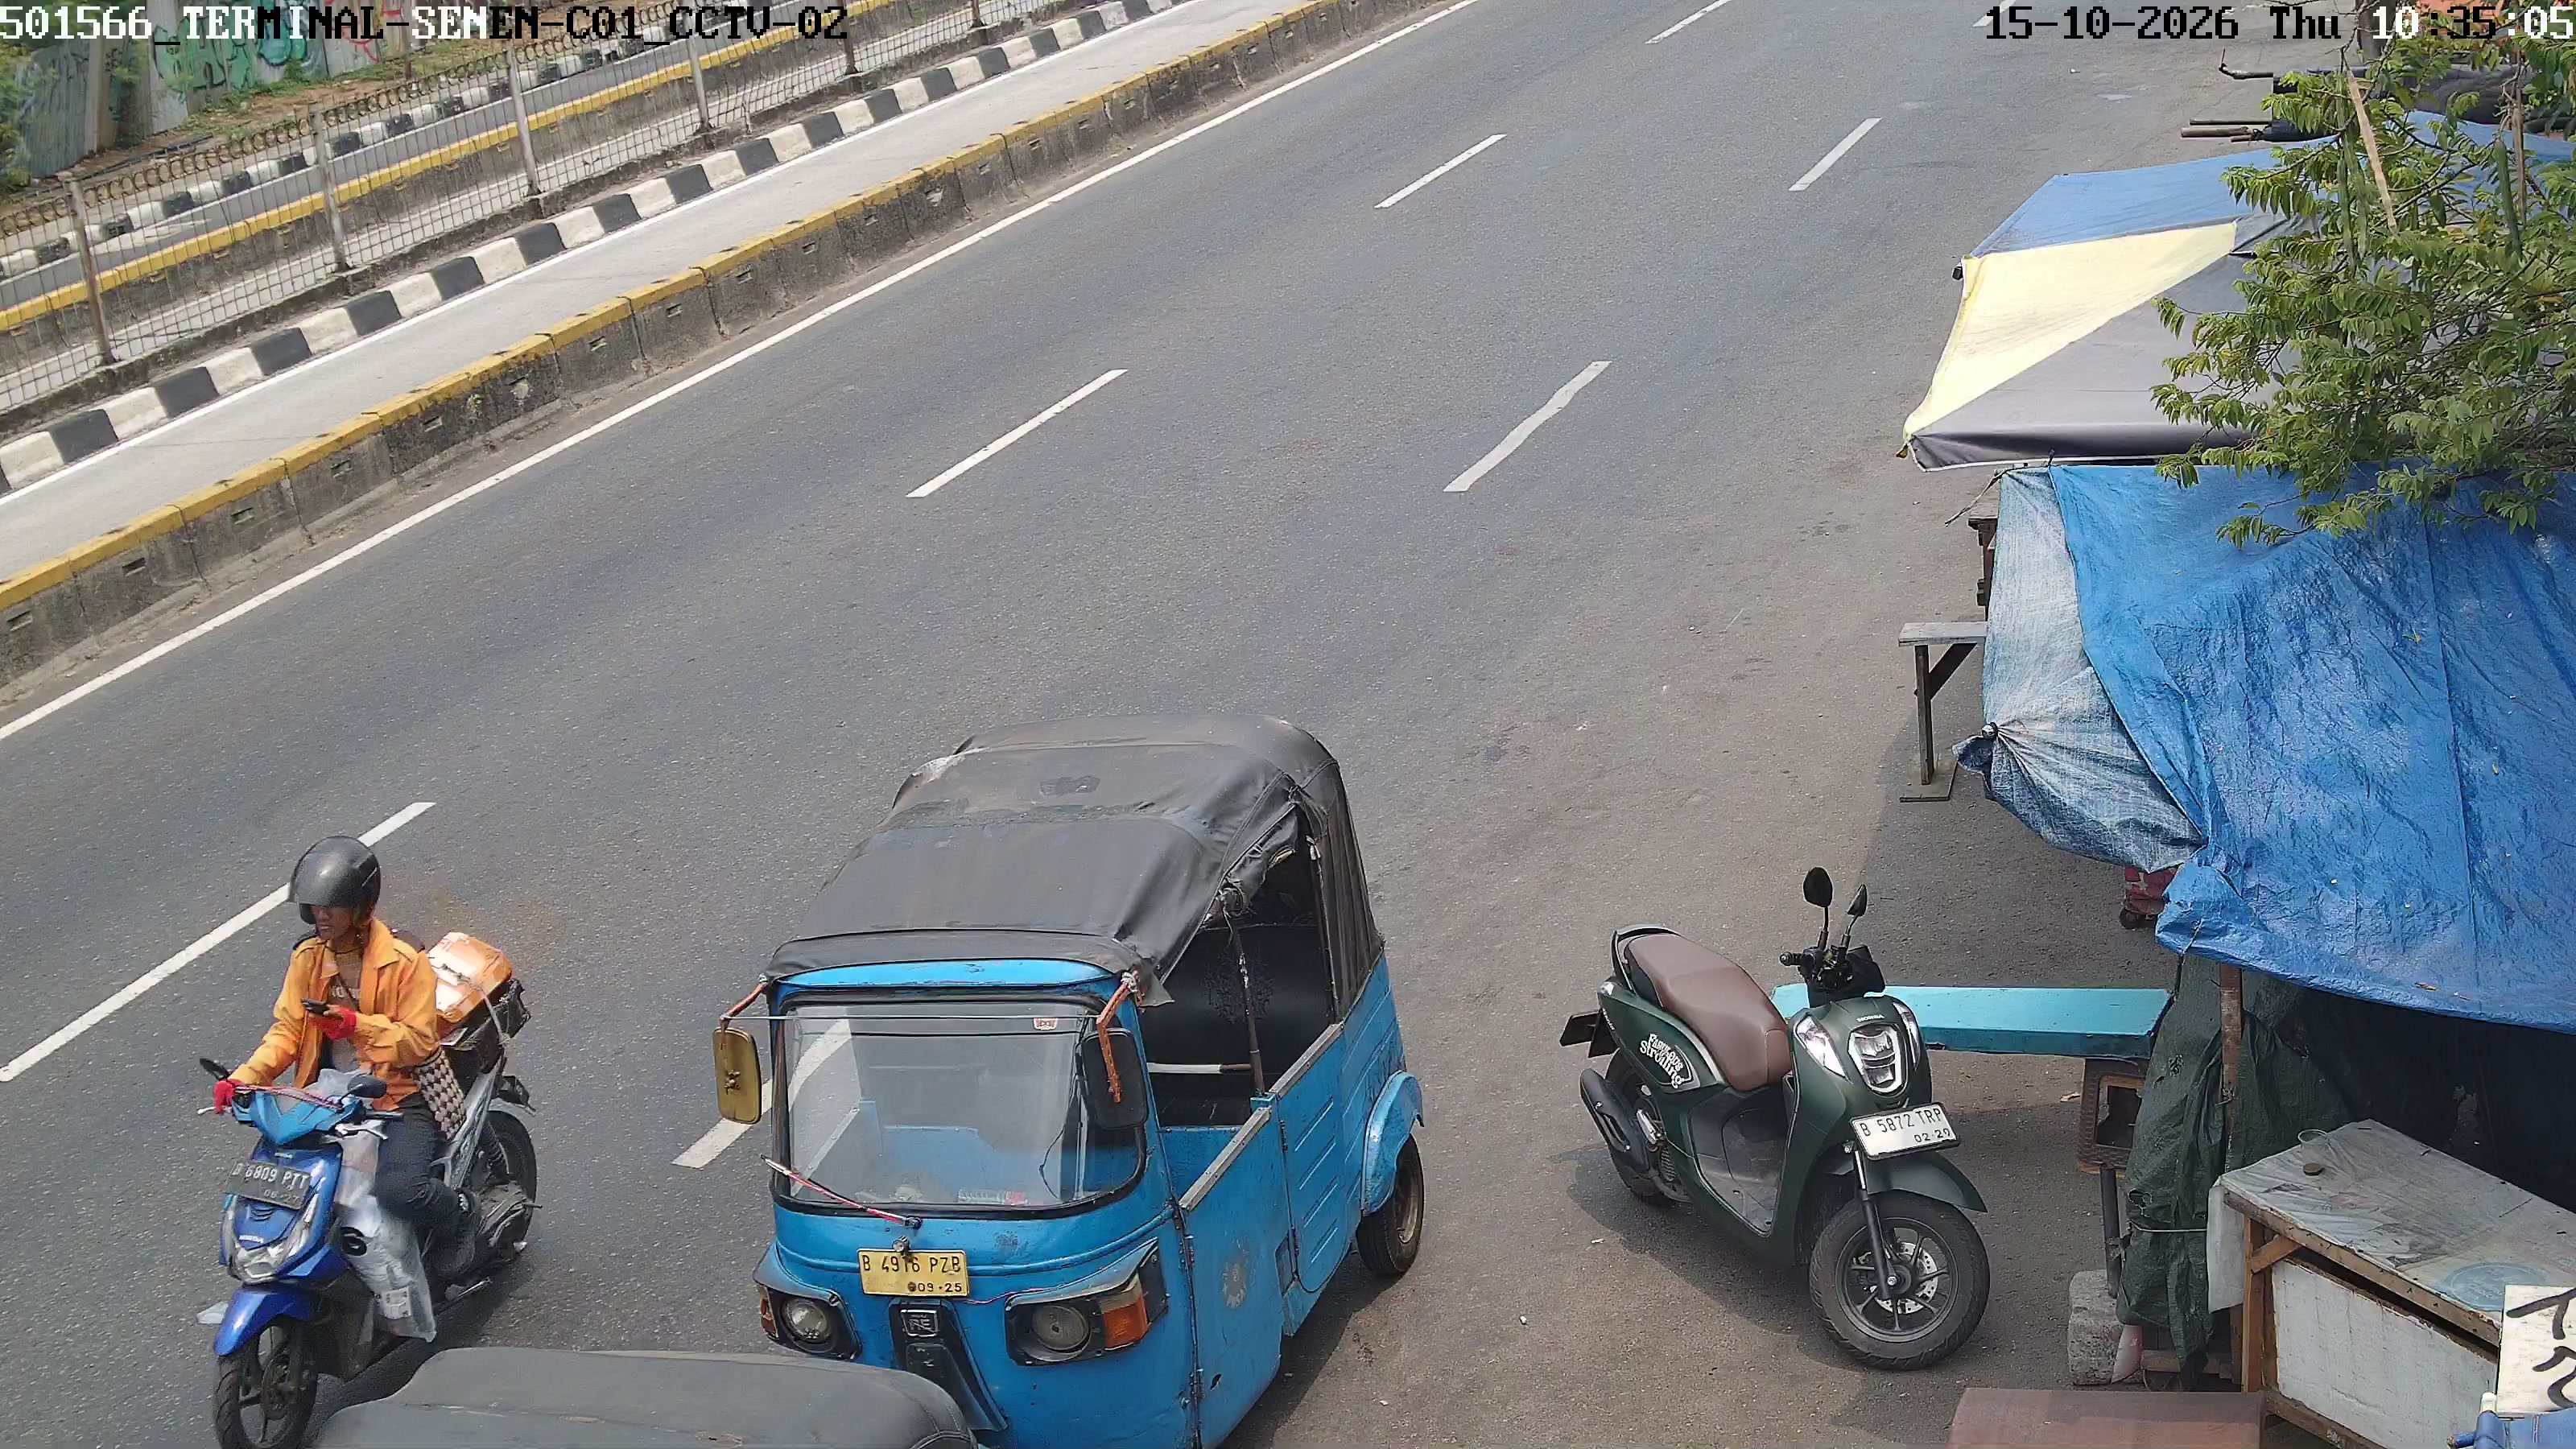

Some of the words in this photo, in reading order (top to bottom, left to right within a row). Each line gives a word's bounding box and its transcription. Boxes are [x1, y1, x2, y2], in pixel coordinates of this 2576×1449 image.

[1859, 1122, 1872, 1137] B
[1876, 1113, 1915, 1133] 5872
[1915, 1108, 1942, 1125] TRP
[861, 1254, 871, 1272] B
[881, 1255, 921, 1273] 4916
[929, 1256, 961, 1274] PZB
